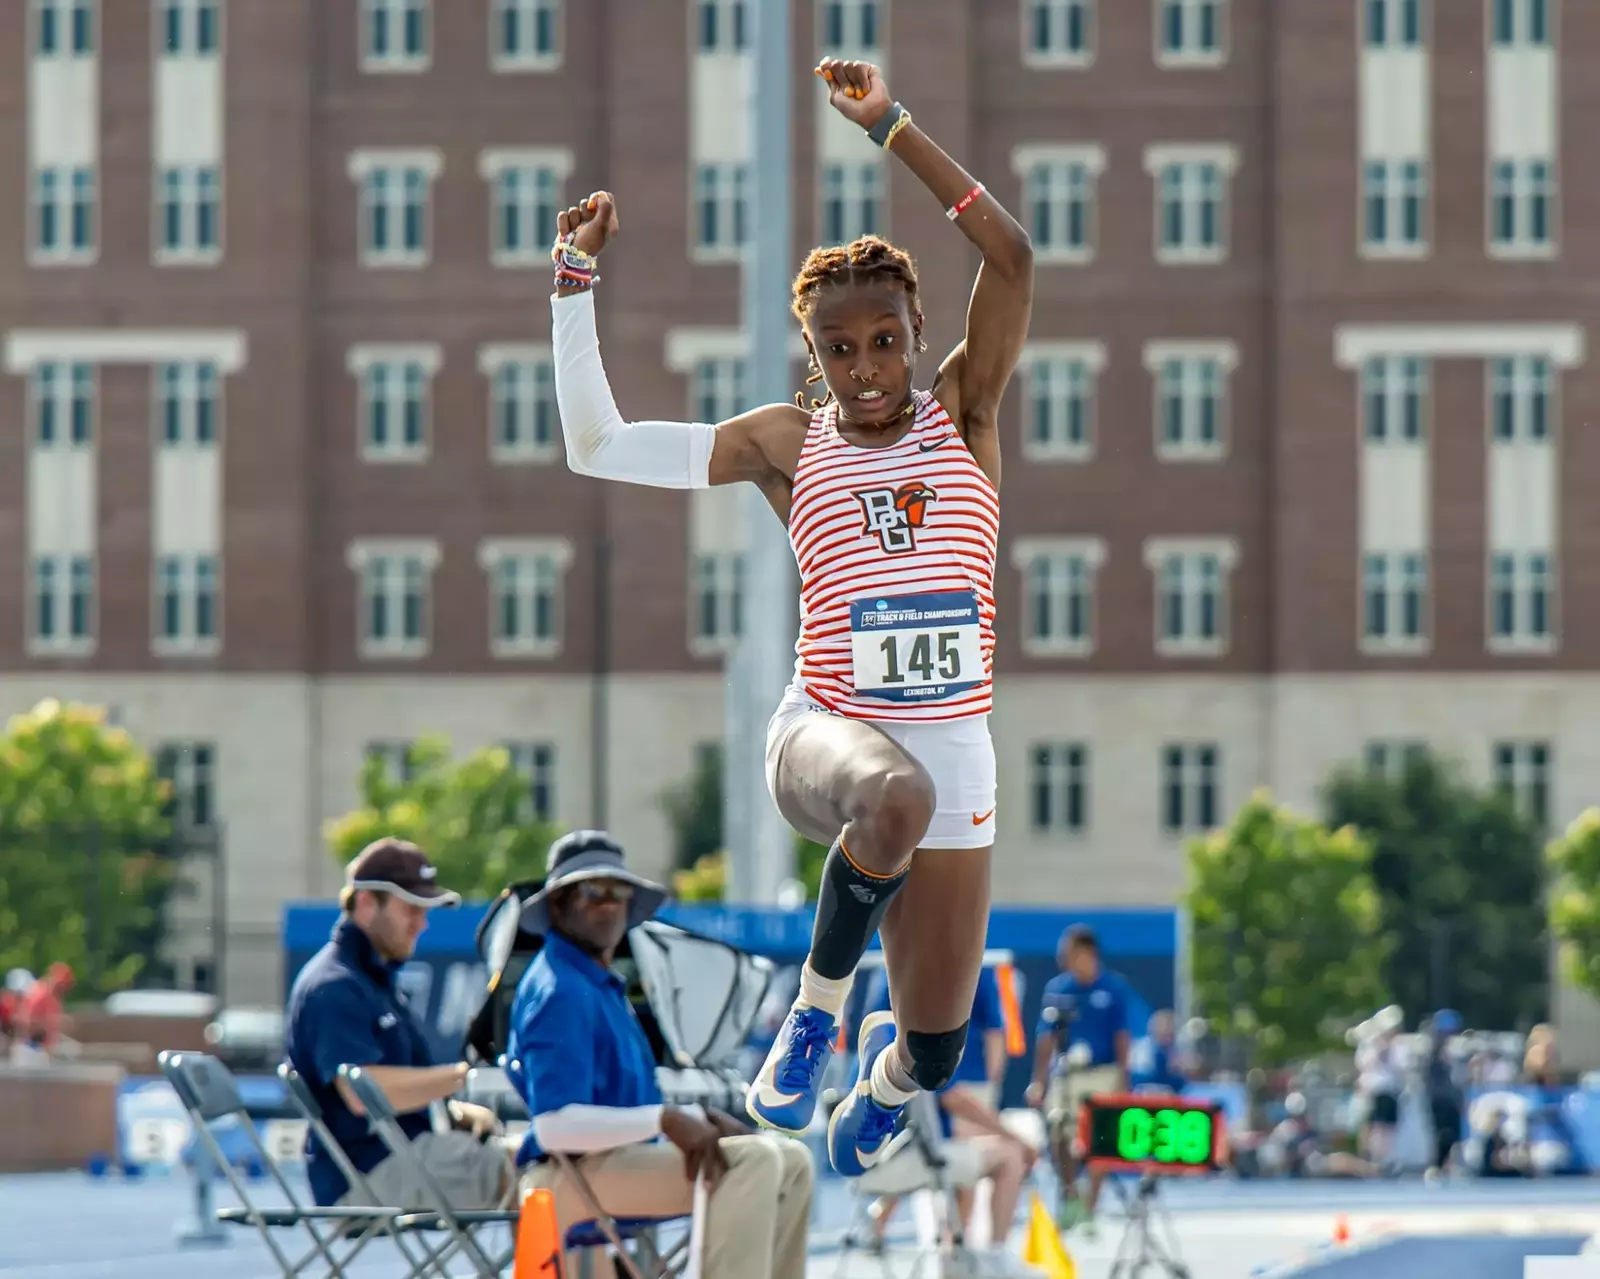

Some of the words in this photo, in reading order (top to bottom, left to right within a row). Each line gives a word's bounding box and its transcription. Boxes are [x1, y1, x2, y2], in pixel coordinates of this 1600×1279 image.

[854, 488, 915, 553] BG
[877, 613, 898, 622] TRACK
[905, 612, 923, 621] FIELD
[924, 609, 972, 619] CHAMPIONSHIPS
[880, 631, 961, 684] 145
[937, 685, 946, 694] KY
